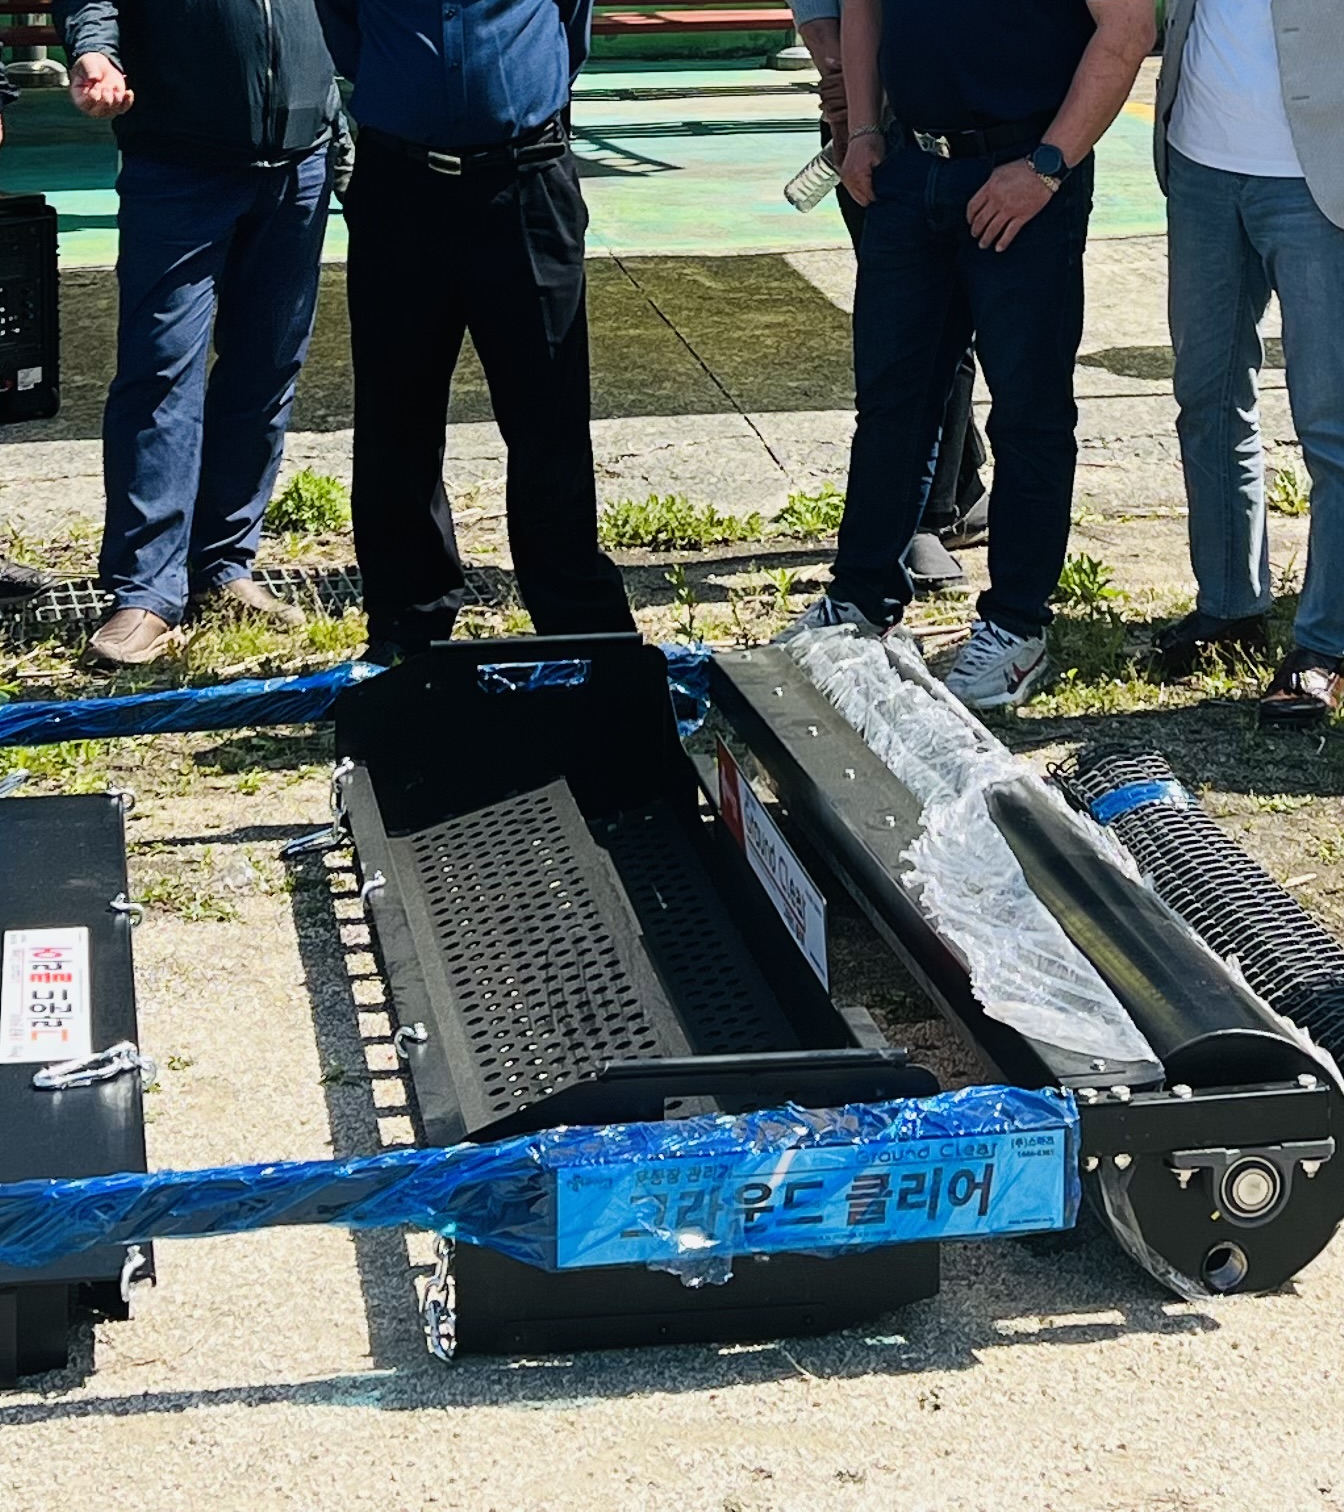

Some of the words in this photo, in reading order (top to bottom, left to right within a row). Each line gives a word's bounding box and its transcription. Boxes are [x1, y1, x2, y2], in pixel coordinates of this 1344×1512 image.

[857, 1145, 930, 1163] Ground
[940, 1141, 998, 1160] Clear
[846, 1163, 994, 1226] 클리어
